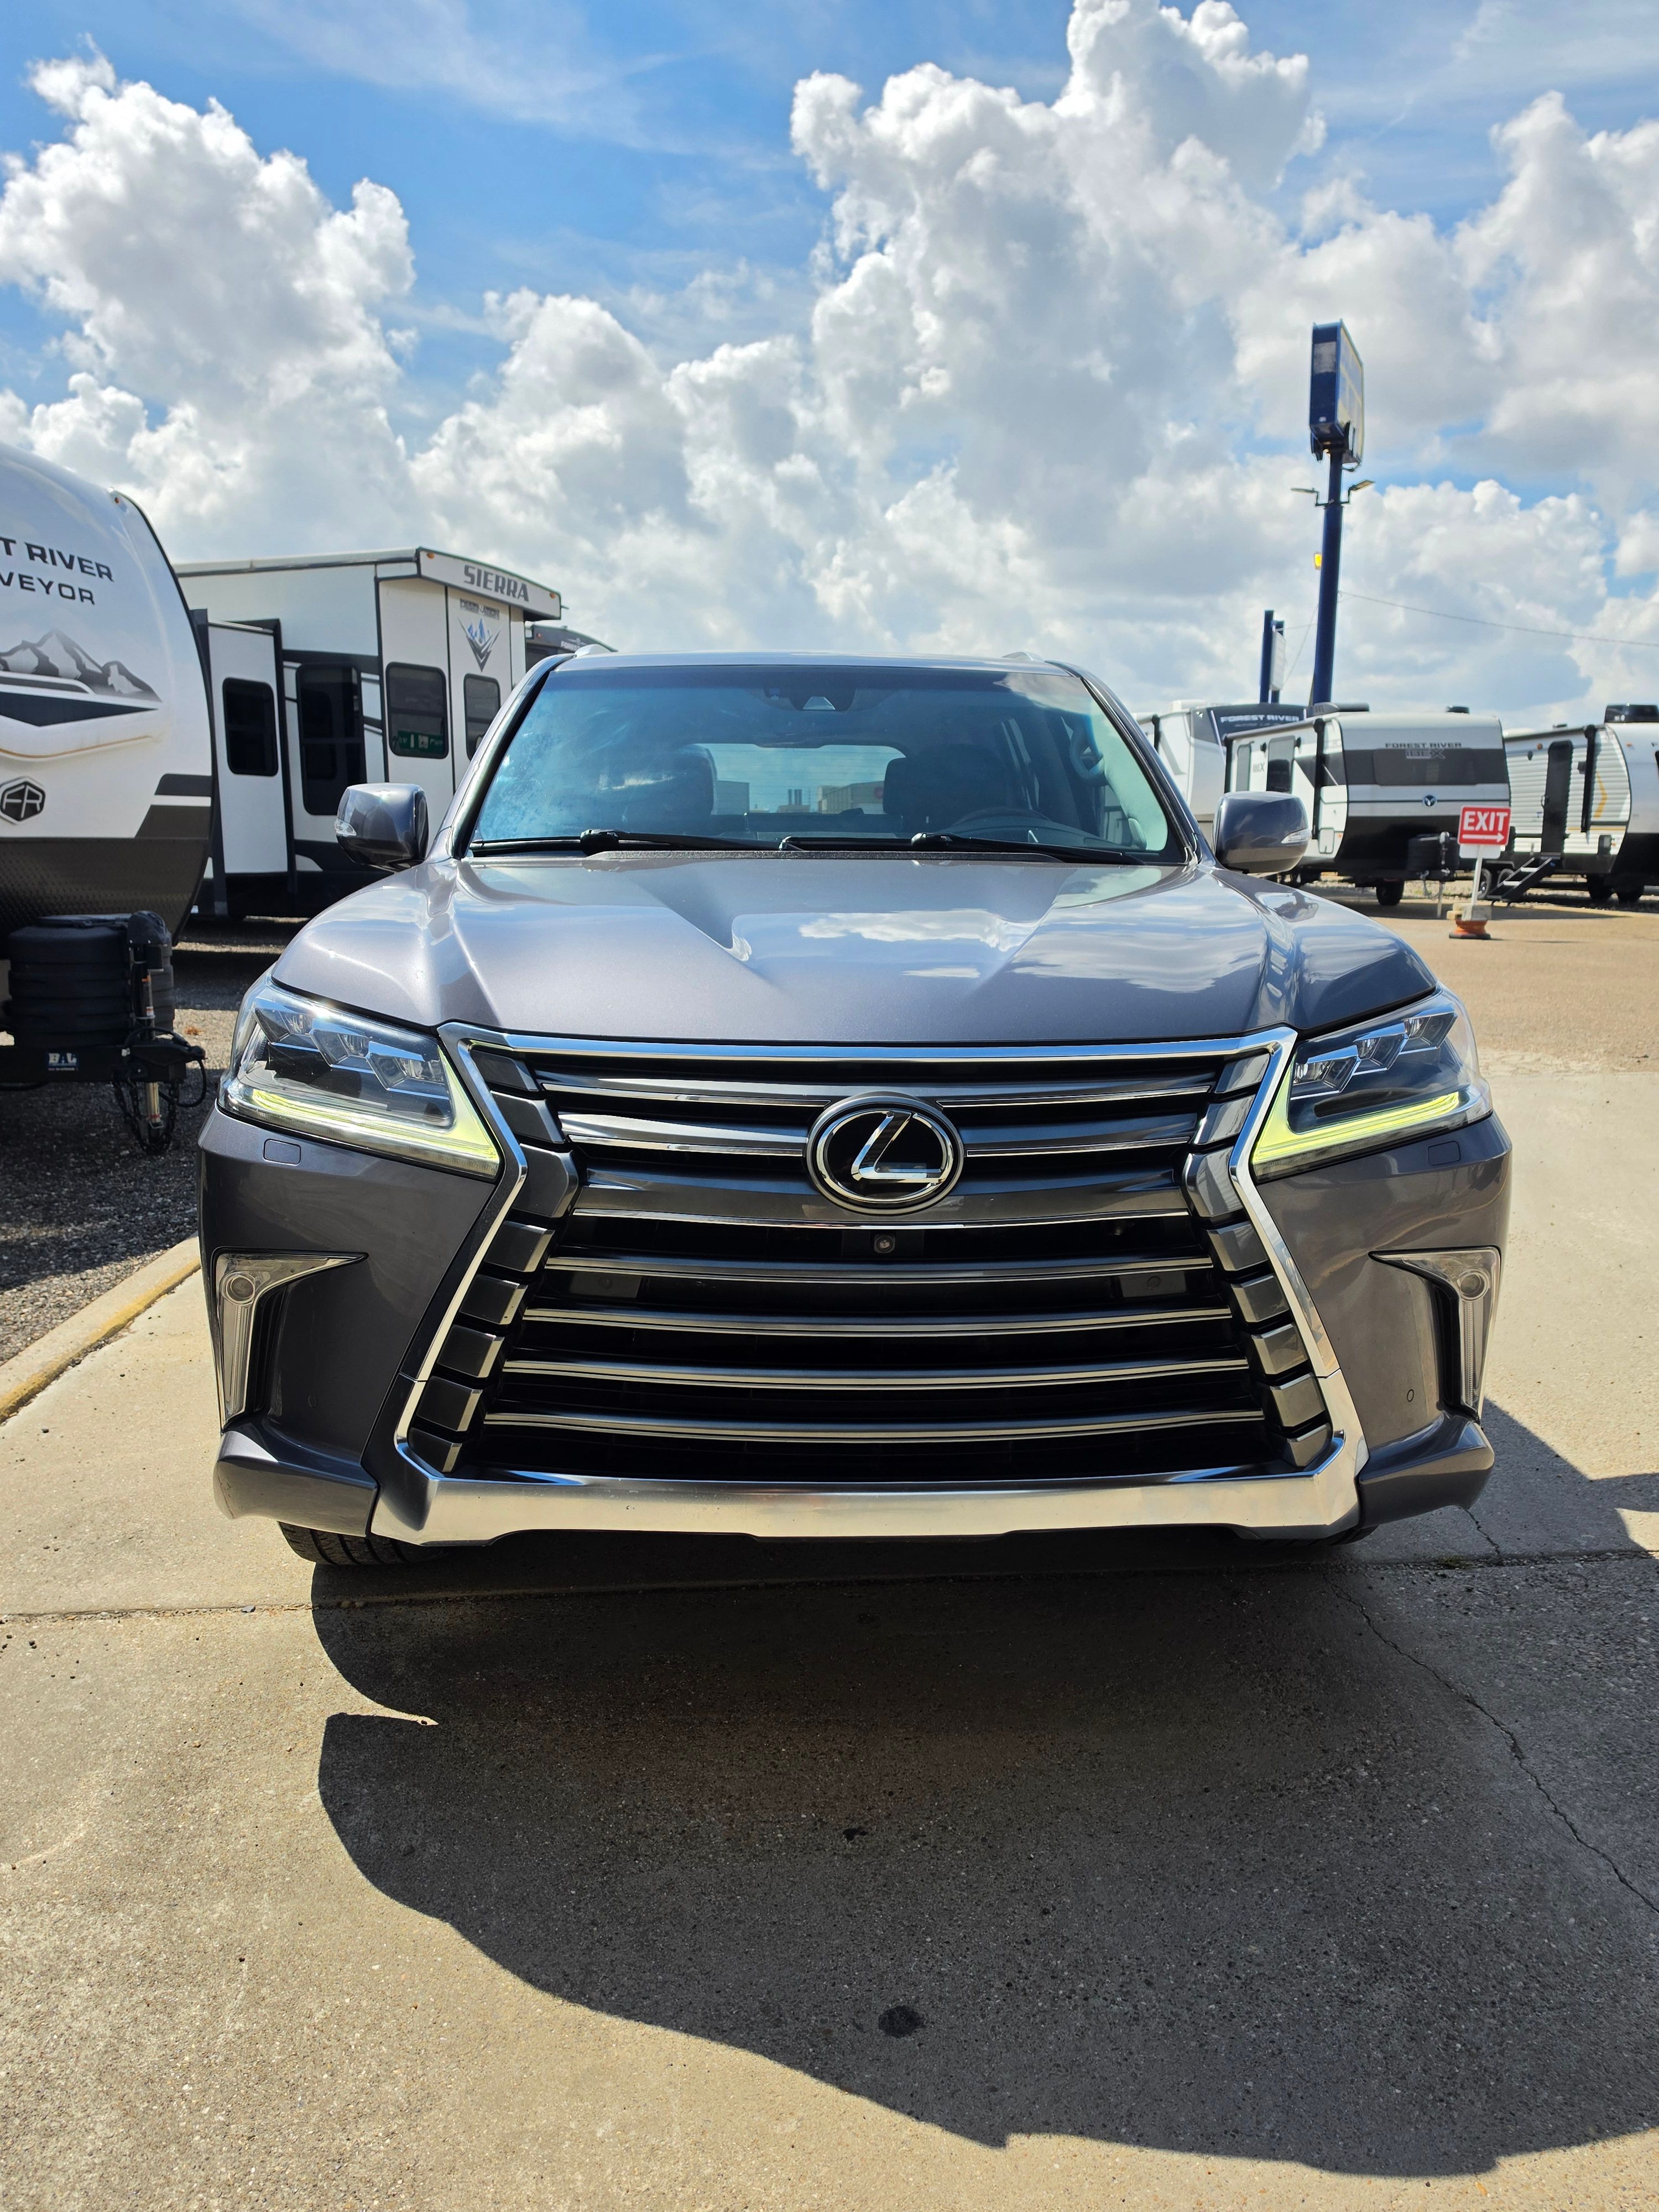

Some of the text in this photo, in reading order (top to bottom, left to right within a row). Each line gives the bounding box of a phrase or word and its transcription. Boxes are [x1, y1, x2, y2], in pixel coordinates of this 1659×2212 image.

[24, 541, 114, 582] RIVER
[463, 565, 529, 602] SIERRA
[1220, 714, 1265, 723] FOREST
[1463, 811, 1509, 832] EXIT
